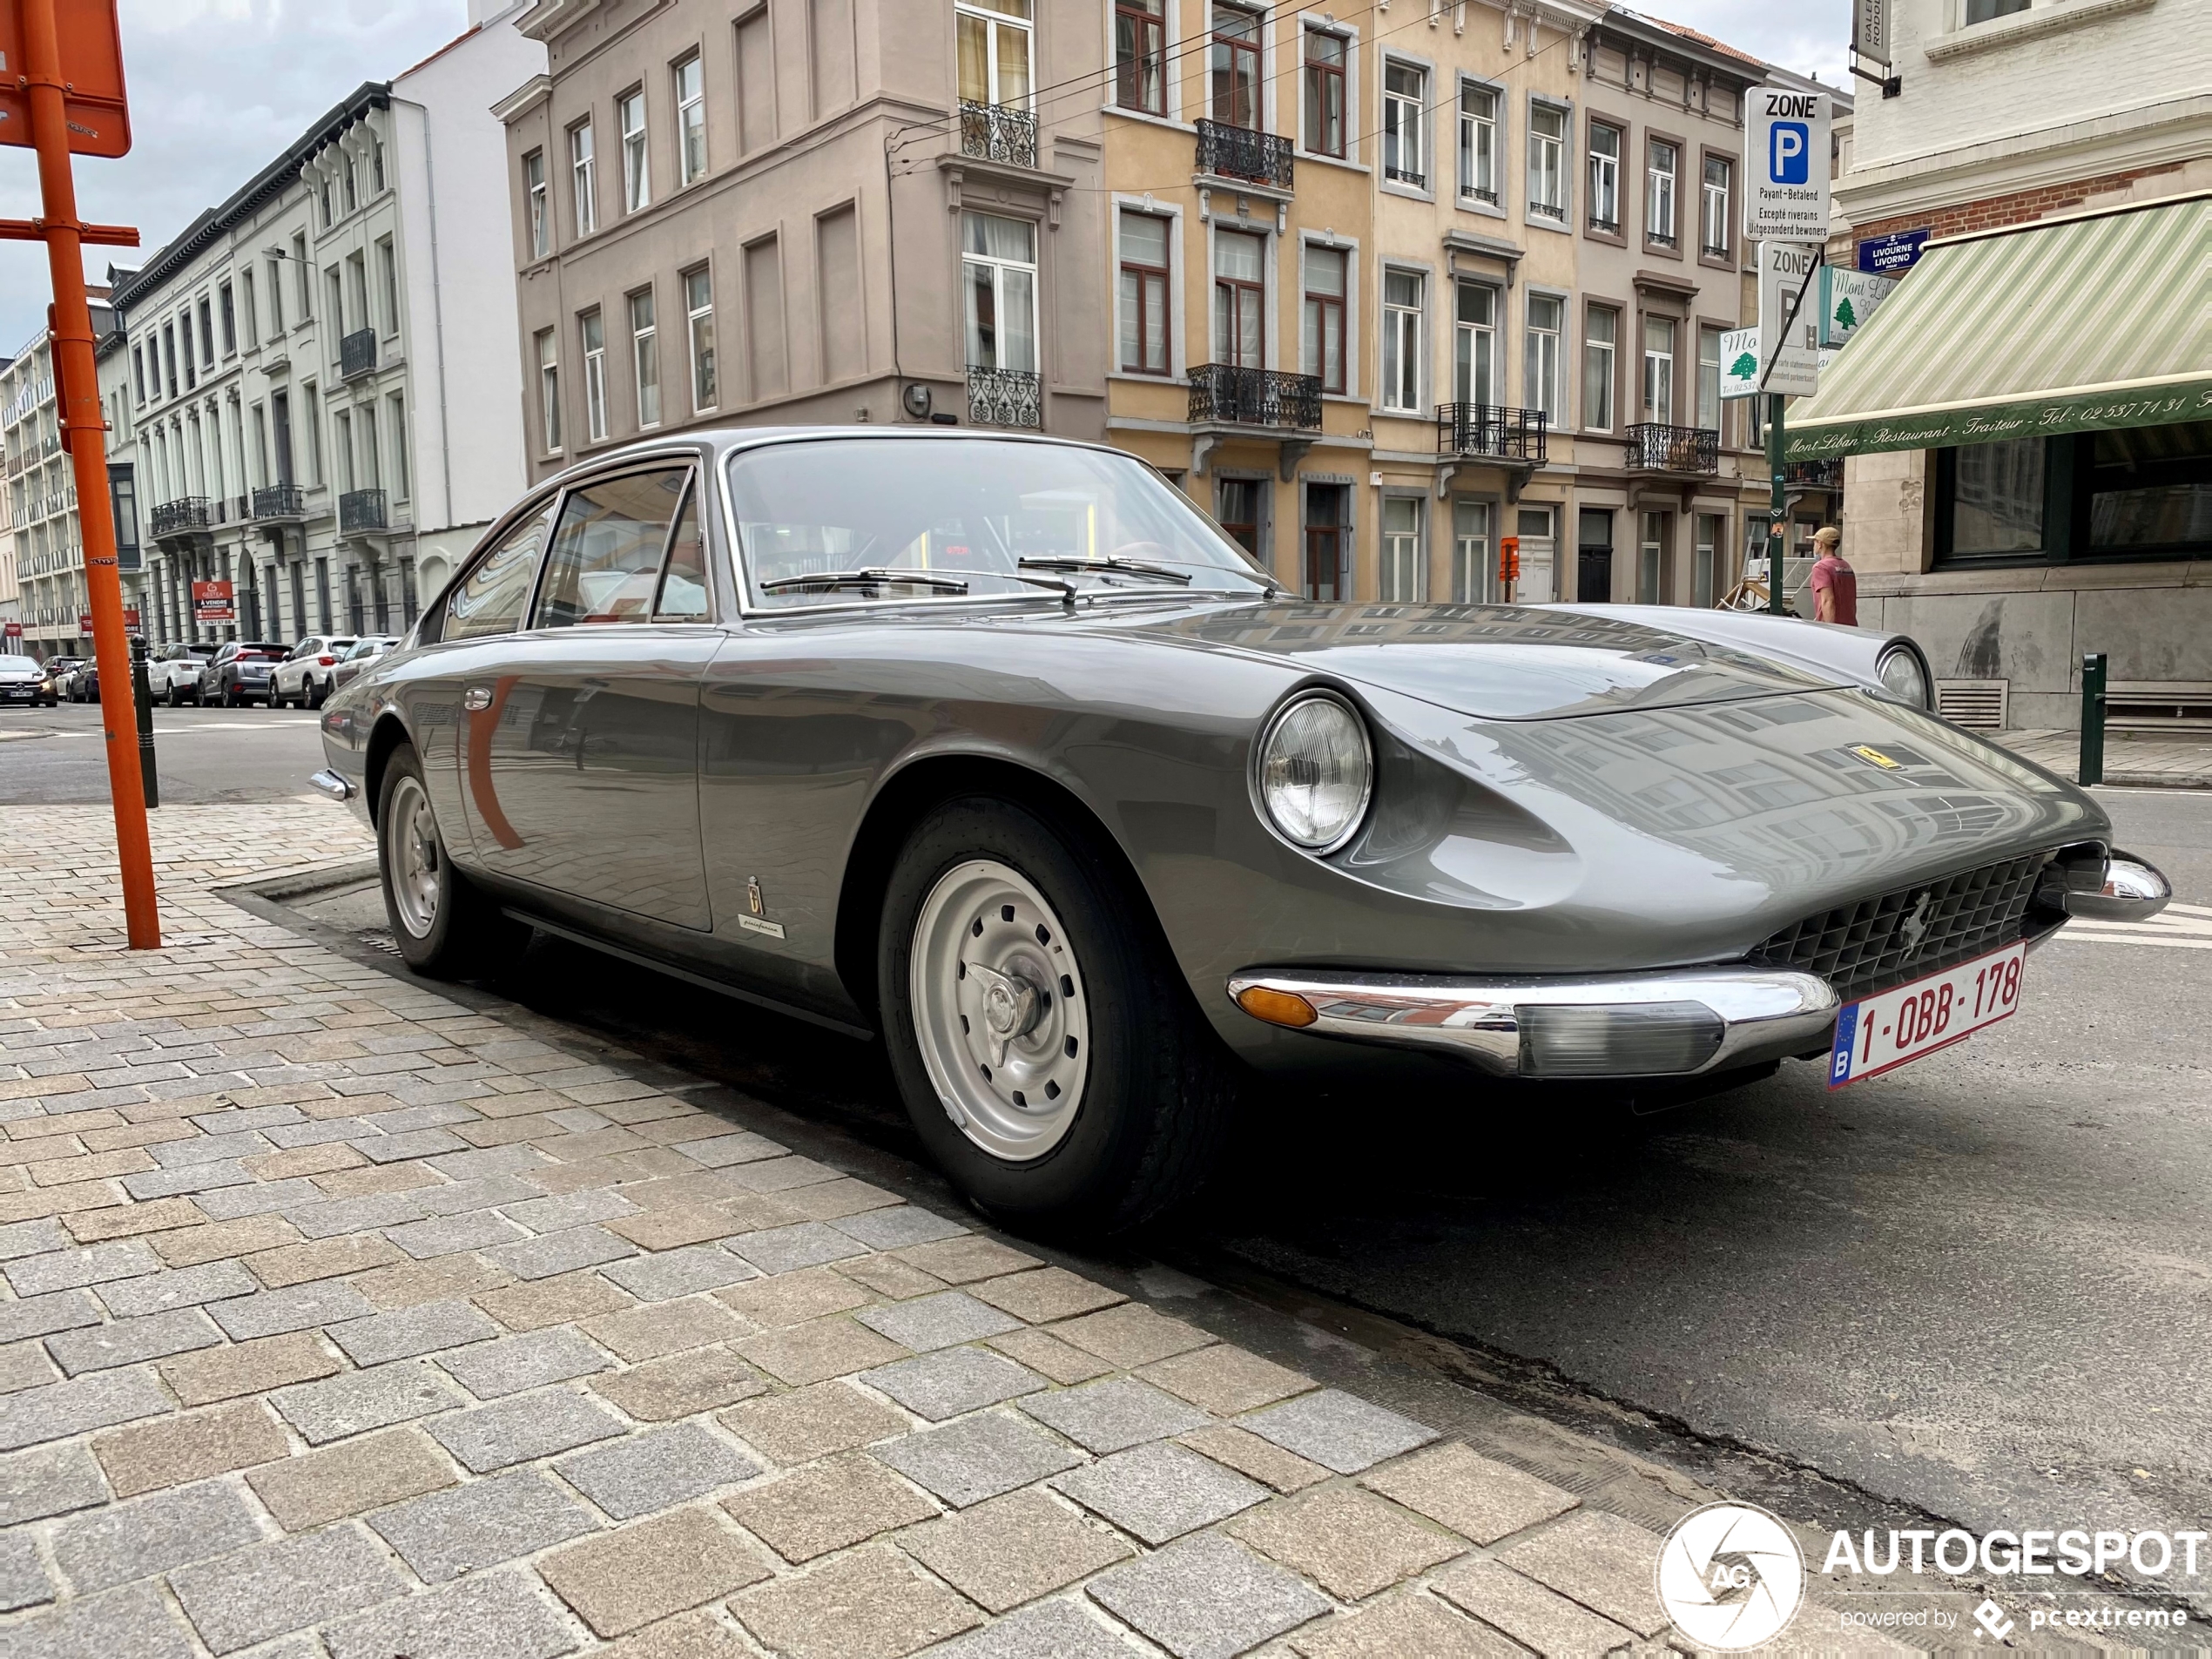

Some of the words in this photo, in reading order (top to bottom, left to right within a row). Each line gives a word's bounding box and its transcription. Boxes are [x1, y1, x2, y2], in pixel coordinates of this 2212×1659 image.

[1766, 95, 1817, 118] ZONE
[1776, 129, 1803, 176] P
[1759, 208, 1786, 222] Excepté
[1788, 209, 1818, 221] riverains
[1749, 222, 1794, 237] Uitgezonderd
[1796, 225, 1827, 236] bewoners
[1773, 250, 1810, 275] ZONE
[1872, 244, 1912, 258] LIVOURNE
[1875, 253, 1910, 266] LIVORNO
[1834, 271, 1865, 296] Mont
[1785, 438, 1818, 455] Mont
[1818, 434, 1858, 450] Liban
[1871, 426, 1950, 444] Restaurant
[1962, 417, 2024, 435] Traiteur
[2080, 407, 2104, 421] 02
[2104, 402, 2137, 419] 537
[1835, 1050, 1849, 1078] B
